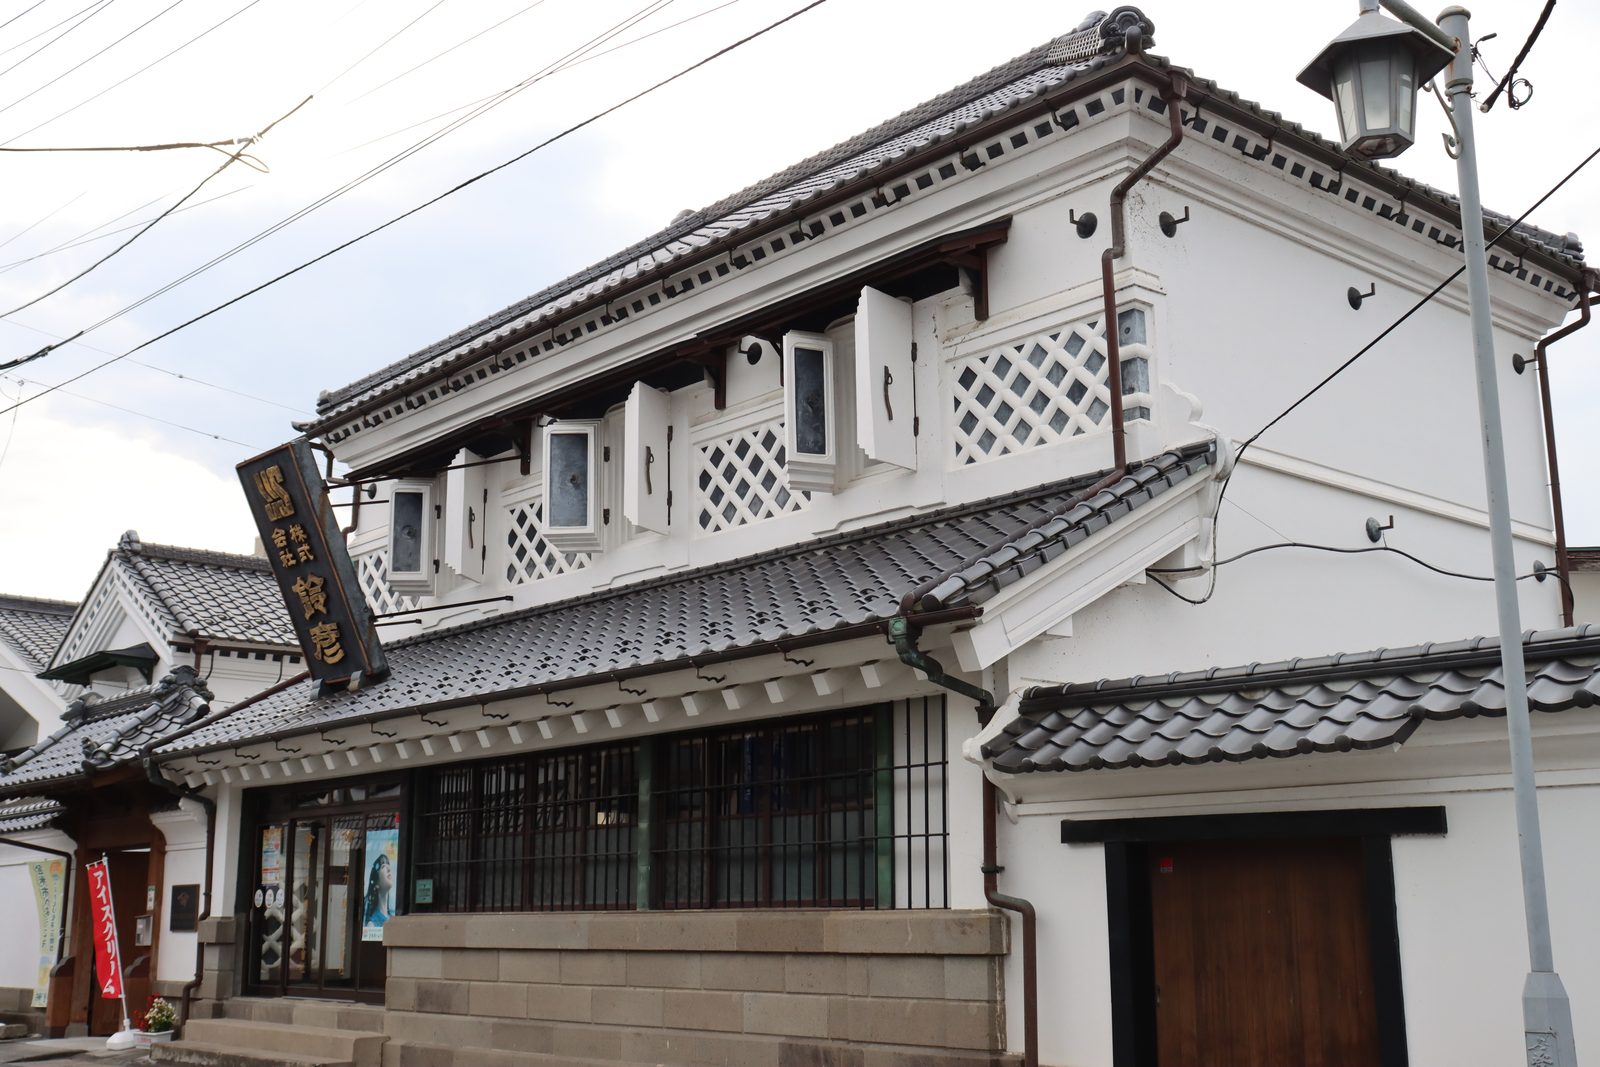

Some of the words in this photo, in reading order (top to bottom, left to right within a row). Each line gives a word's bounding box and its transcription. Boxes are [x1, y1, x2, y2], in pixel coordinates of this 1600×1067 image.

[93, 870, 117, 994] アイスクリーム
